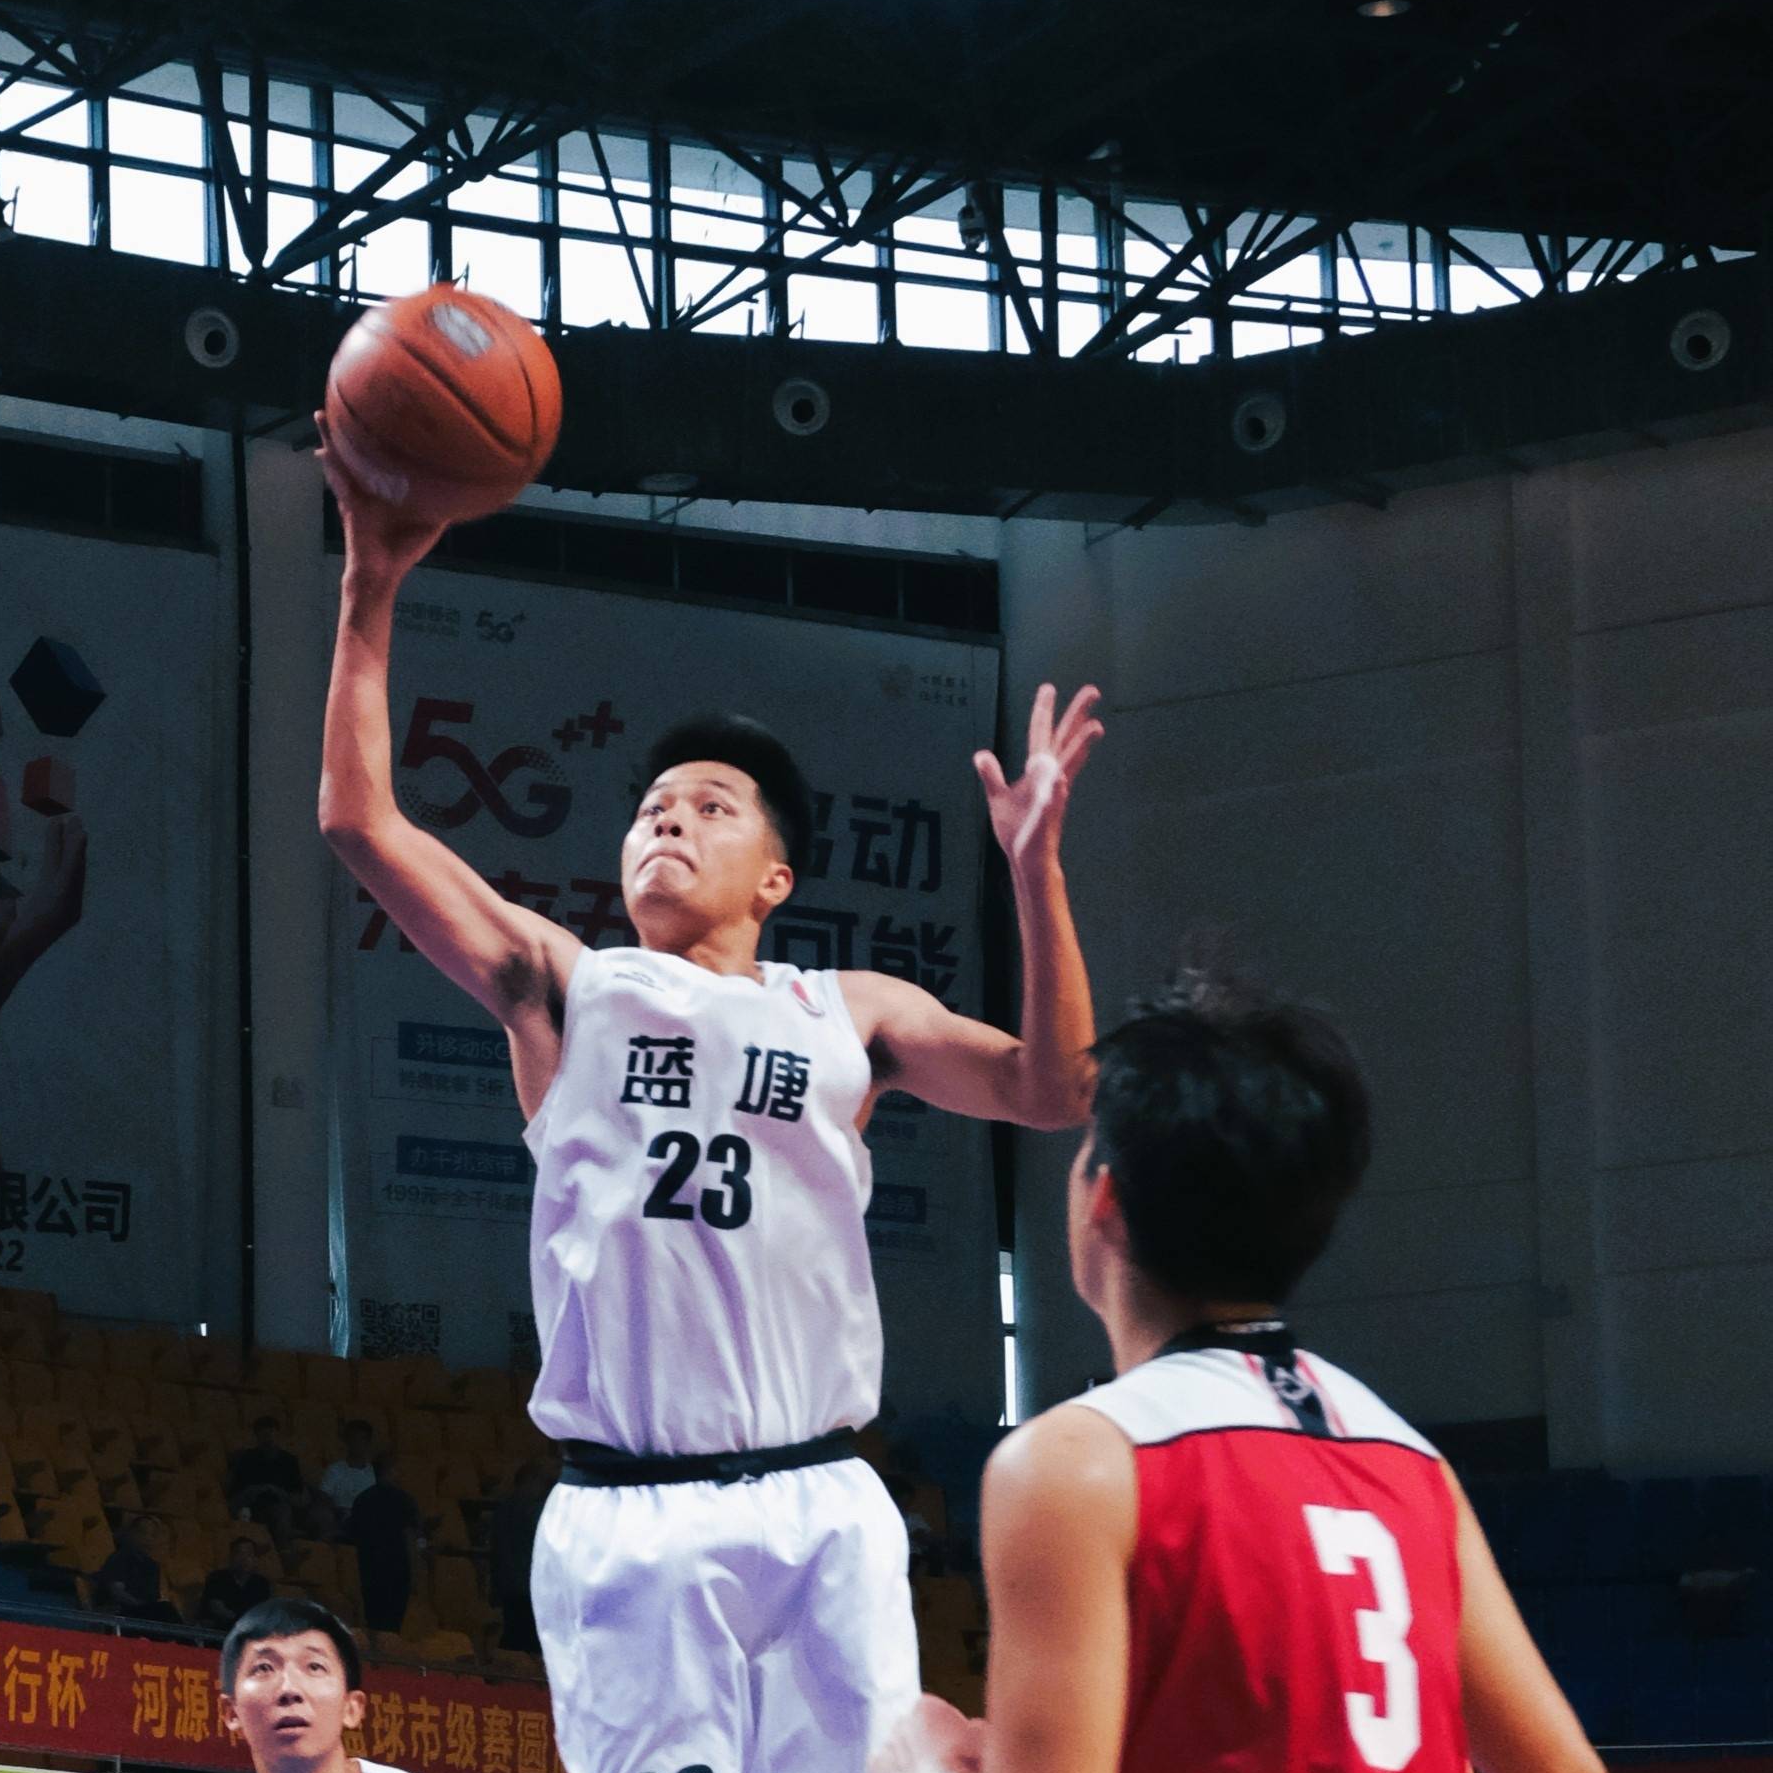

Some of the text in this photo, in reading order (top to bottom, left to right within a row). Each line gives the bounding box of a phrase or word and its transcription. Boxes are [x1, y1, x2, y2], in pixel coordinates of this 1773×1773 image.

[619, 1034, 812, 1124] 蓝塘
[642, 1130, 753, 1231] 23
[1302, 1503, 1422, 1772] 3
